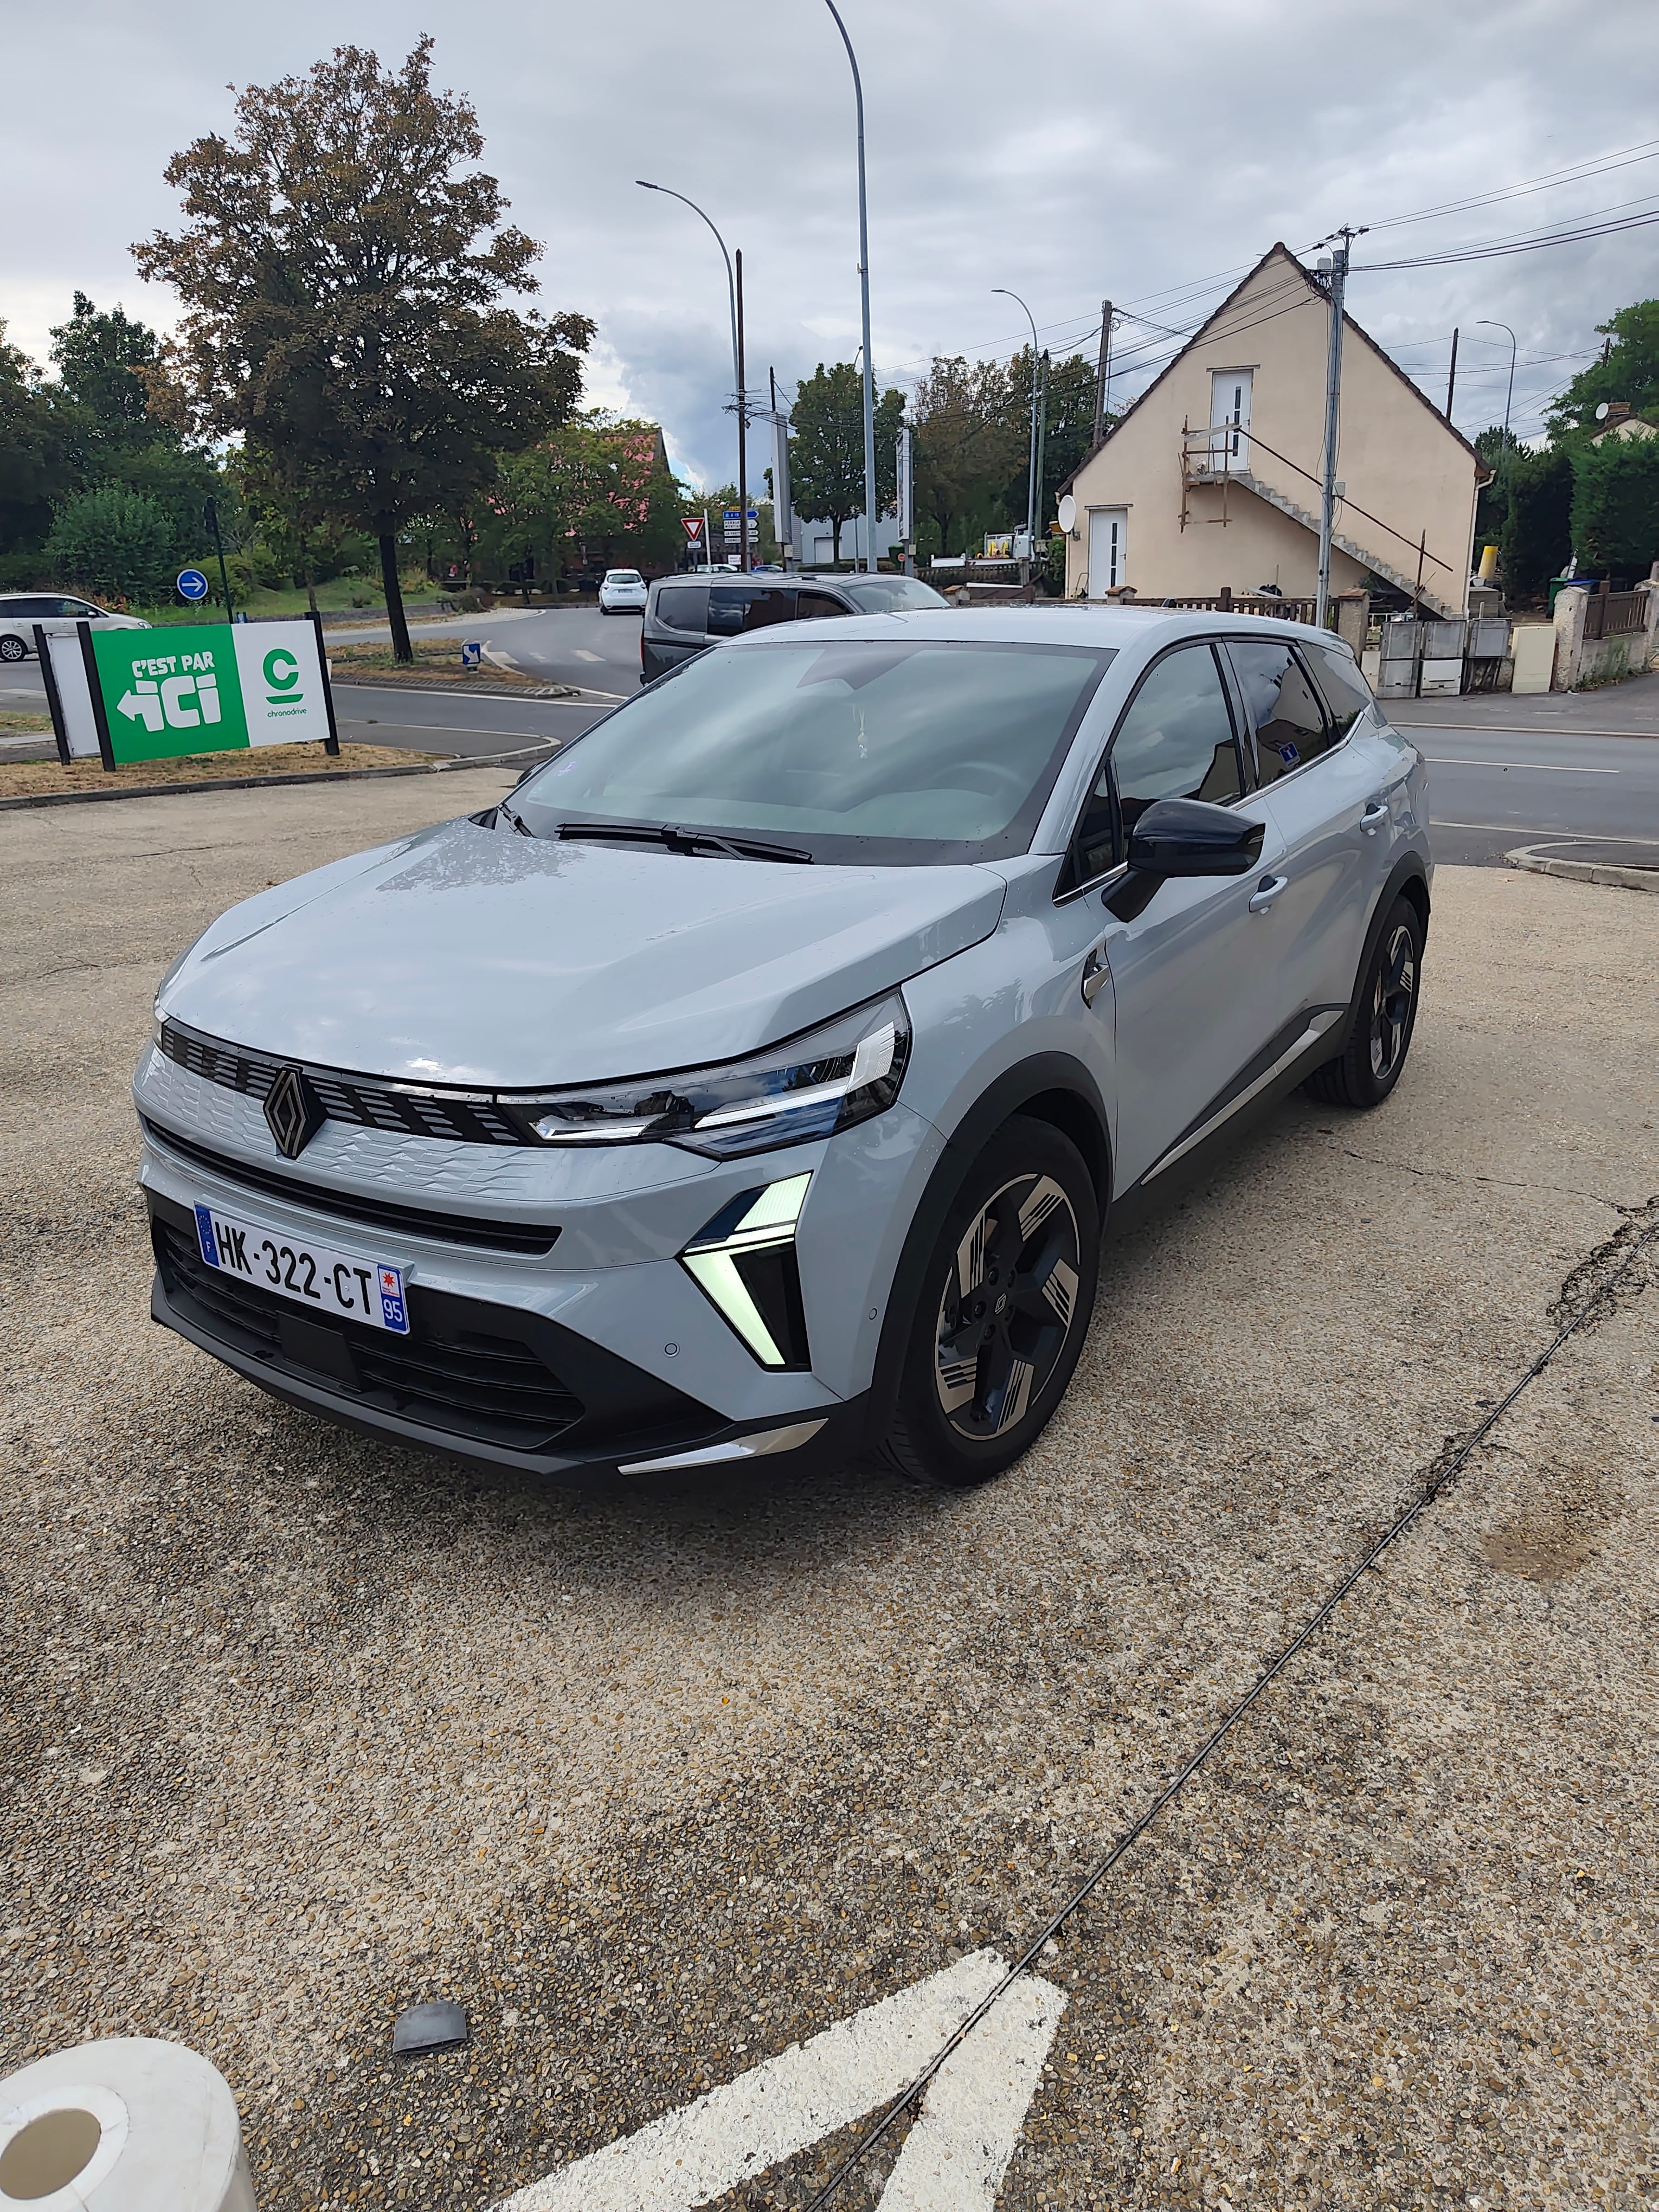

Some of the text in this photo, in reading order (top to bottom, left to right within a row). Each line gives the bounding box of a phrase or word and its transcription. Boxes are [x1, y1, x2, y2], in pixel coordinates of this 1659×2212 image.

[181, 651, 215, 672] PAR
[267, 708, 307, 718] chronodrive
[205, 1240, 211, 1252] F
[383, 1298, 403, 1322] 95
